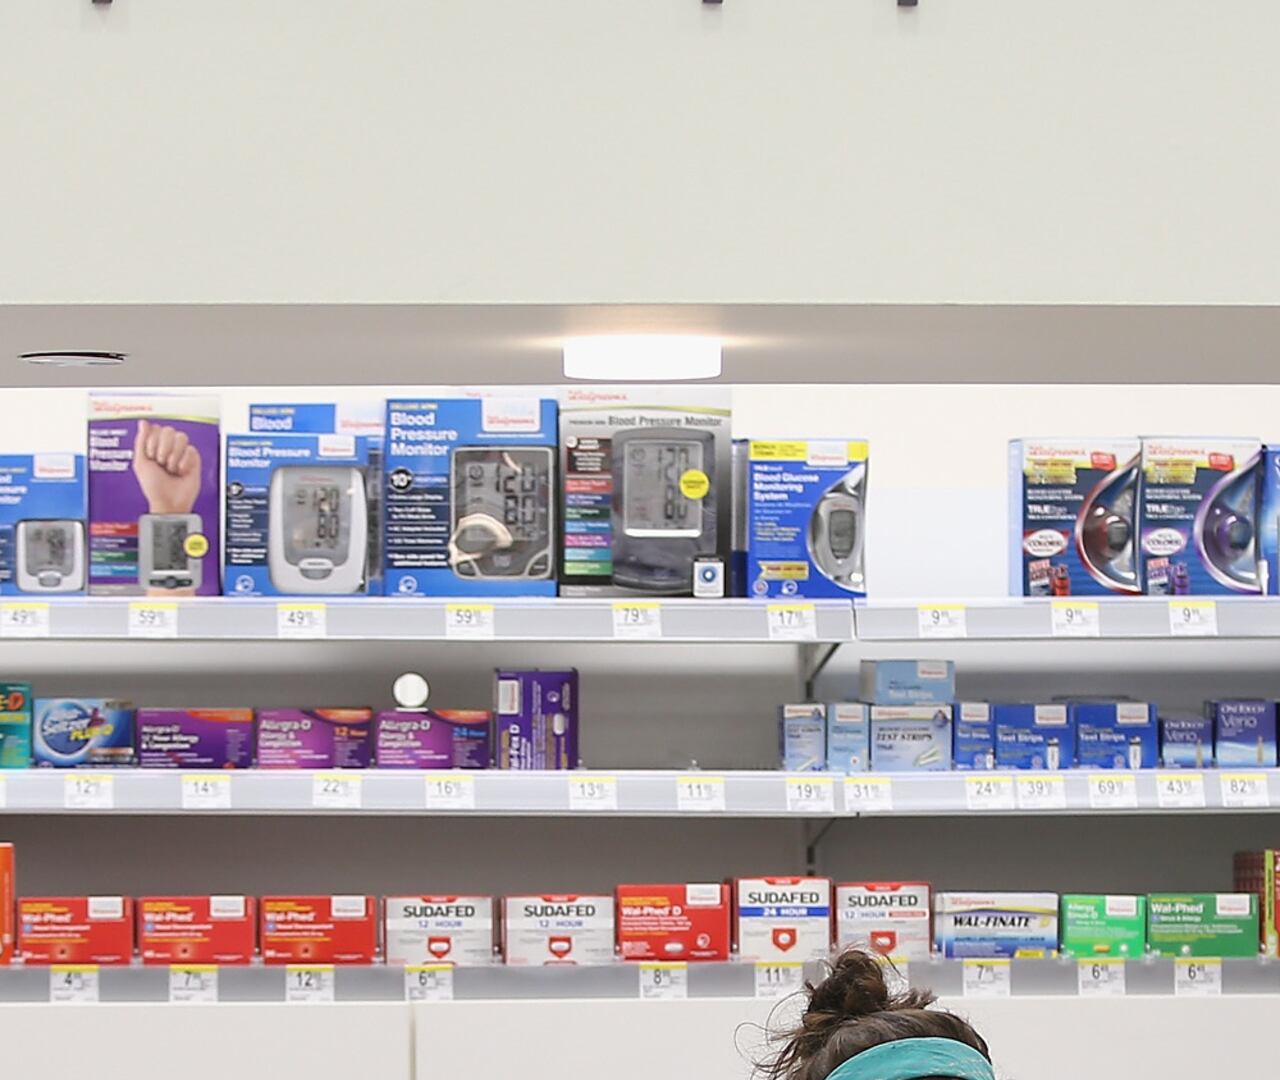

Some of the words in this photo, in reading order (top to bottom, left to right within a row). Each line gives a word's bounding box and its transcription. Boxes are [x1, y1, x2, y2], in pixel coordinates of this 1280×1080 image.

[252, 416, 293, 429] Blood
[390, 412, 434, 425] Blood
[608, 415, 636, 426] Blood
[638, 415, 682, 428] Pressure
[684, 415, 722, 426] Monitor
[390, 427, 458, 441] Pressure
[263, 447, 310, 458] Pressure
[390, 442, 449, 455] Monitor
[1221, 716, 1258, 728] Verio
[748, 891, 819, 904] SUDAFED
[848, 894, 918, 907] SUDAFED
[403, 904, 475, 917] SUDAFED
[524, 904, 595, 917] SUDAFED
[763, 908, 778, 916] 24
[781, 908, 808, 916] HOUR
[1151, 903, 1204, 914] Wal-Phed
[952, 915, 1032, 929] WAL-FINATE
